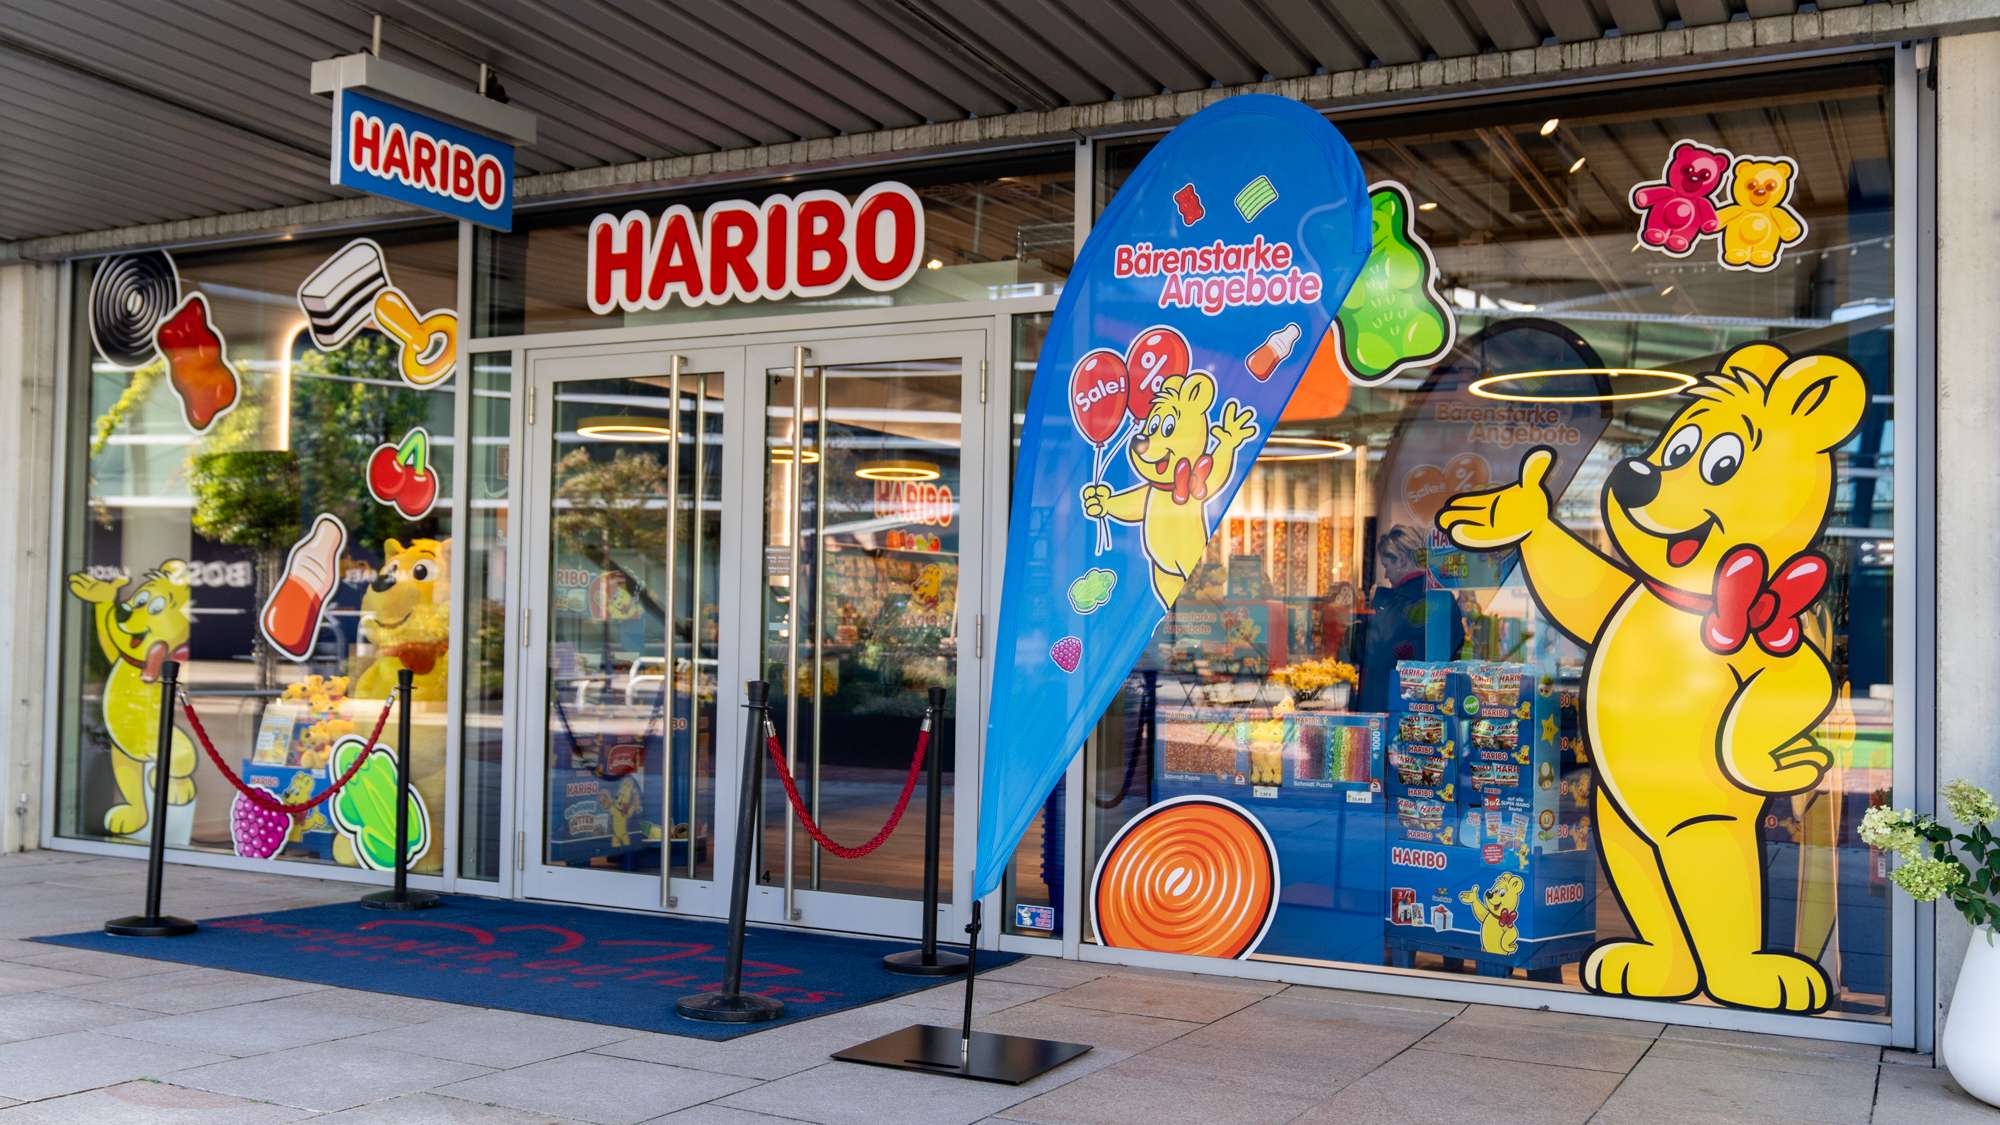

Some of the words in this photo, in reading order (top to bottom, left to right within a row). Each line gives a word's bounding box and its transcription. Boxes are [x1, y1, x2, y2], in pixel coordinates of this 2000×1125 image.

[351, 113, 503, 208] HARIBO
[589, 183, 923, 313] HARIBO
[1115, 236, 1292, 277] Bärenstarke
[1160, 267, 1322, 315] Angebote
[1140, 351, 1167, 393] %
[1075, 376, 1126, 413] Sale!
[1436, 403, 1559, 425] Bärenstarke
[1470, 423, 1580, 447] Angebote
[874, 479, 953, 527] HARIBO
[556, 568, 591, 586] RIBO
[1408, 703, 1435, 713] HARIBO
[1481, 708, 1509, 718] HARIBO
[1408, 745, 1434, 755] HARIBO
[1480, 751, 1508, 761] HARIBO
[566, 782, 599, 797] HARIBO
[1408, 788, 1434, 798] HARIBO
[1407, 830, 1433, 839] HARIBO
[1392, 847, 1447, 870] HARIBO
[1545, 884, 1584, 906] HARIBO
